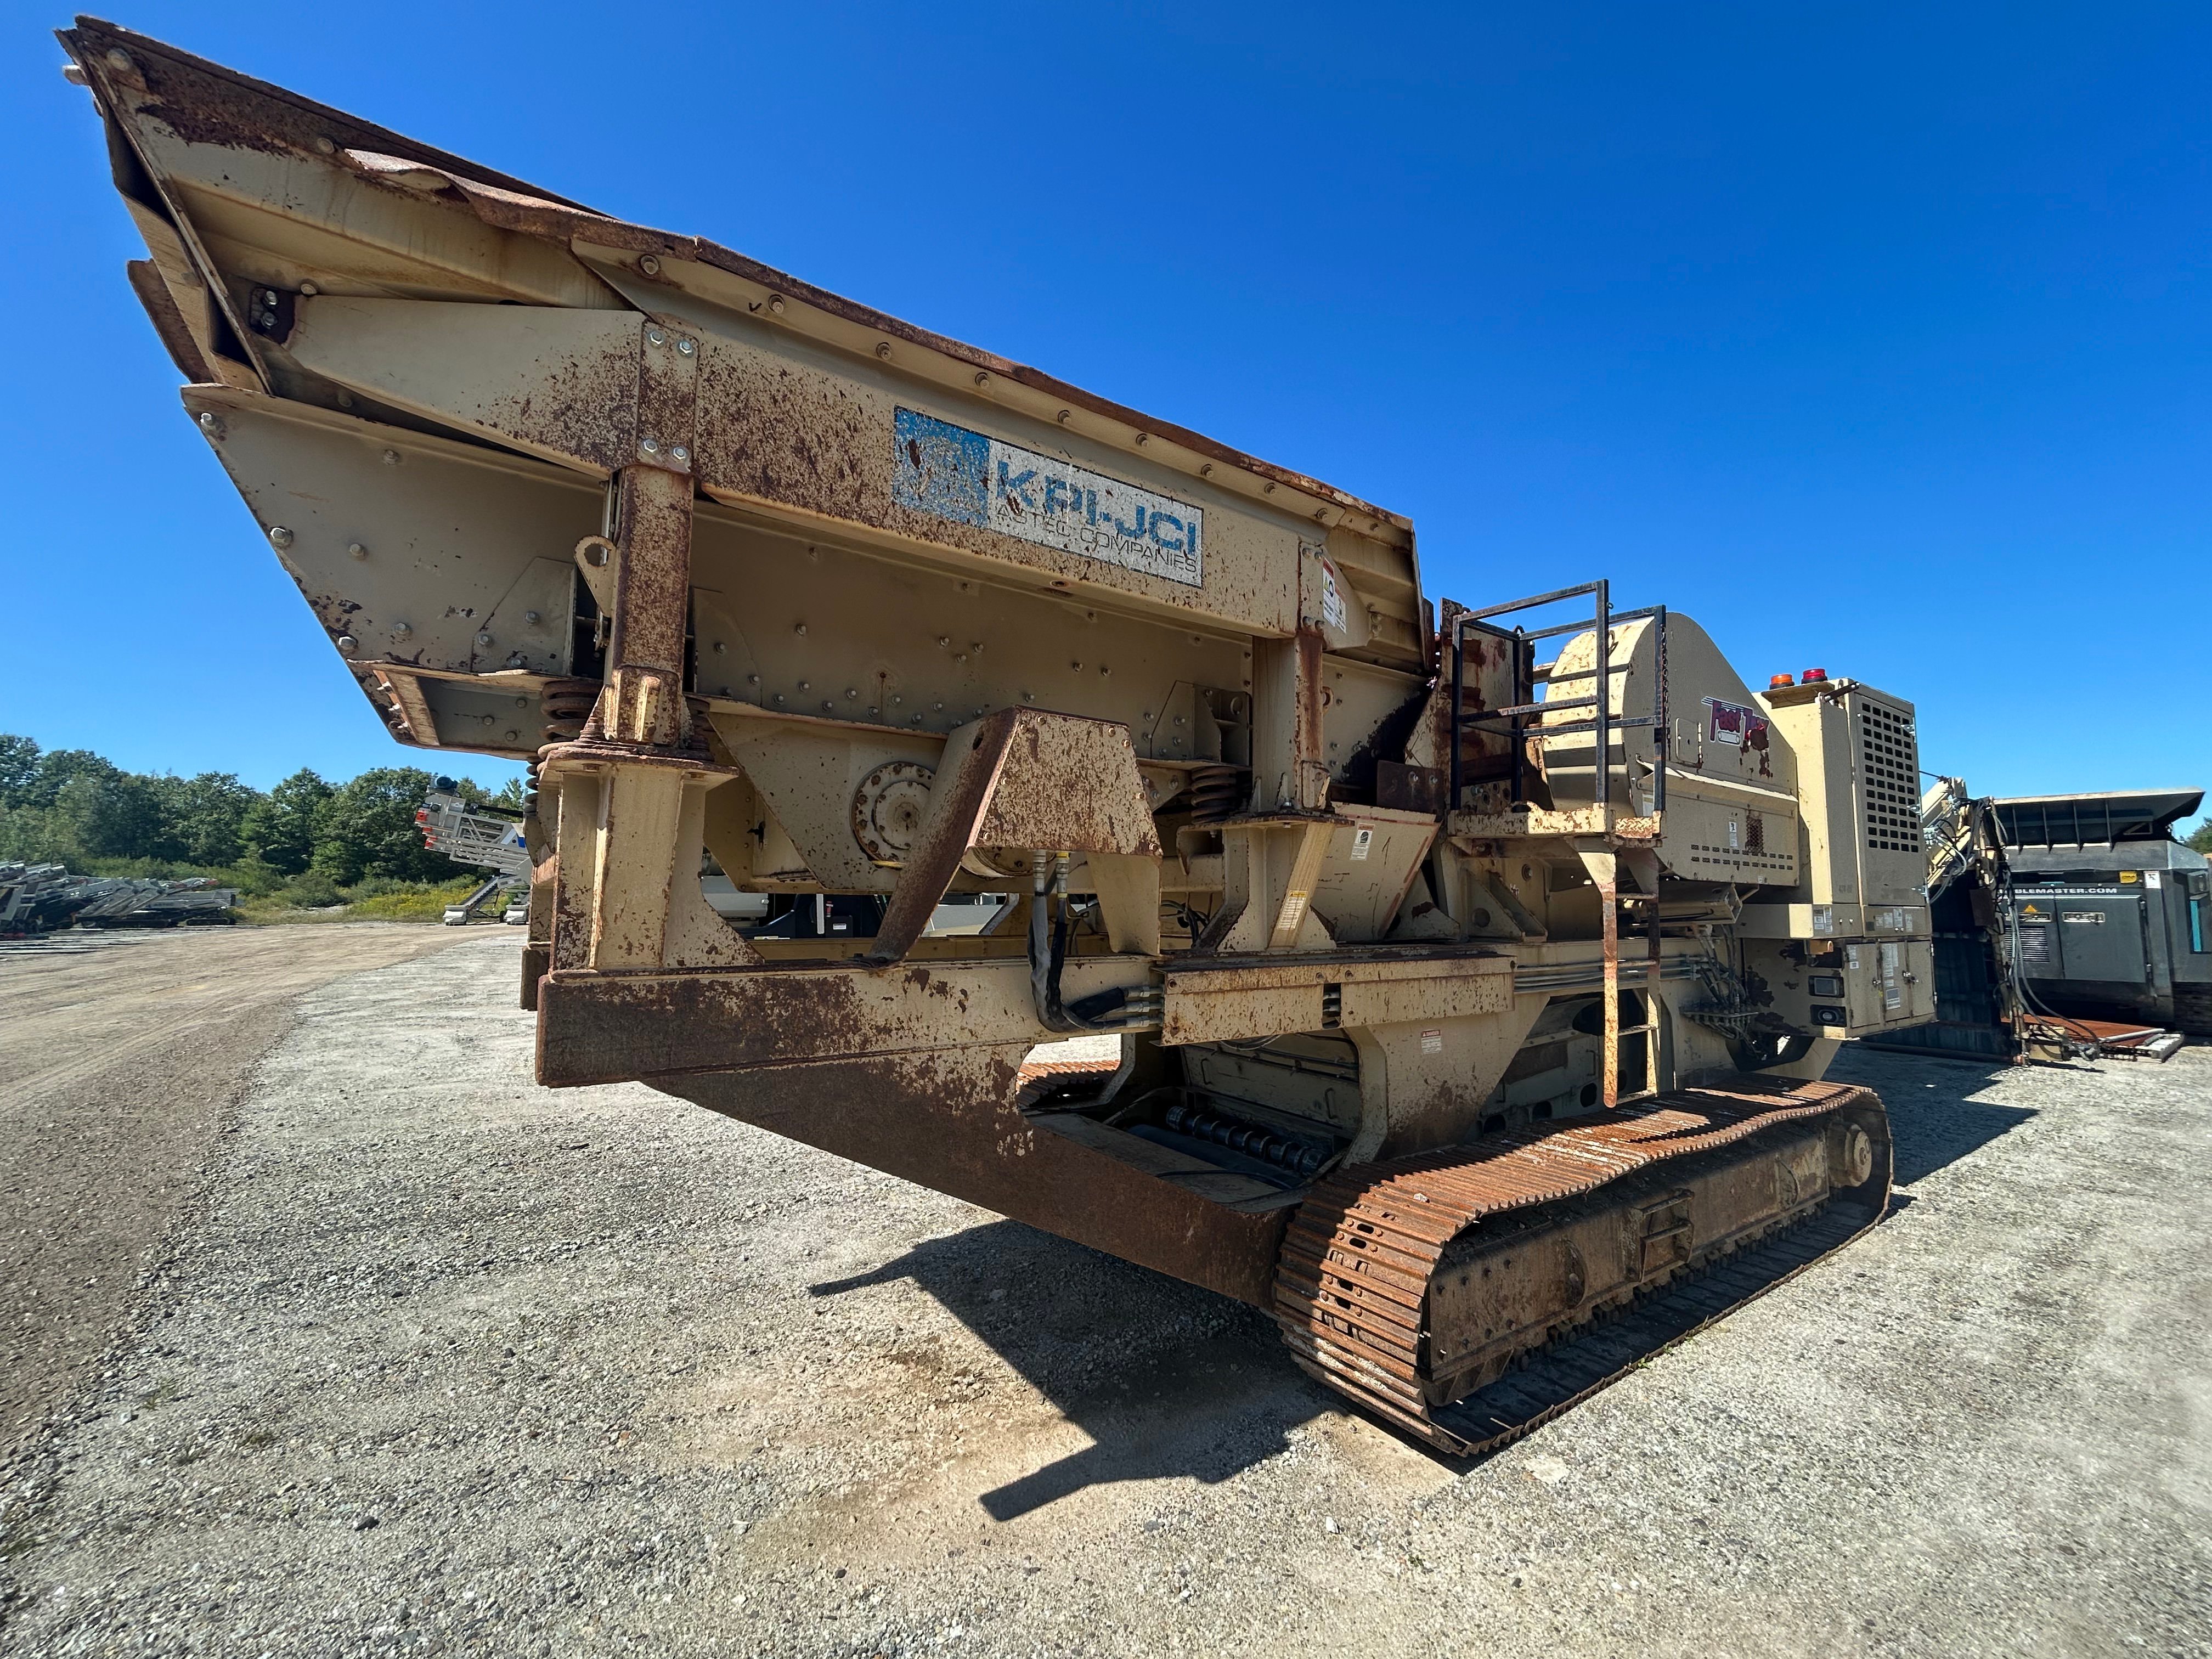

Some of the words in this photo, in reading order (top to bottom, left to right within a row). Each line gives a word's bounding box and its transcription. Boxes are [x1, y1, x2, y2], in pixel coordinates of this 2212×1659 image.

[997, 460, 1196, 556] KPI-JCI
[997, 504, 1071, 537] ASTEC
[1080, 527, 1197, 573] COMPANIES
